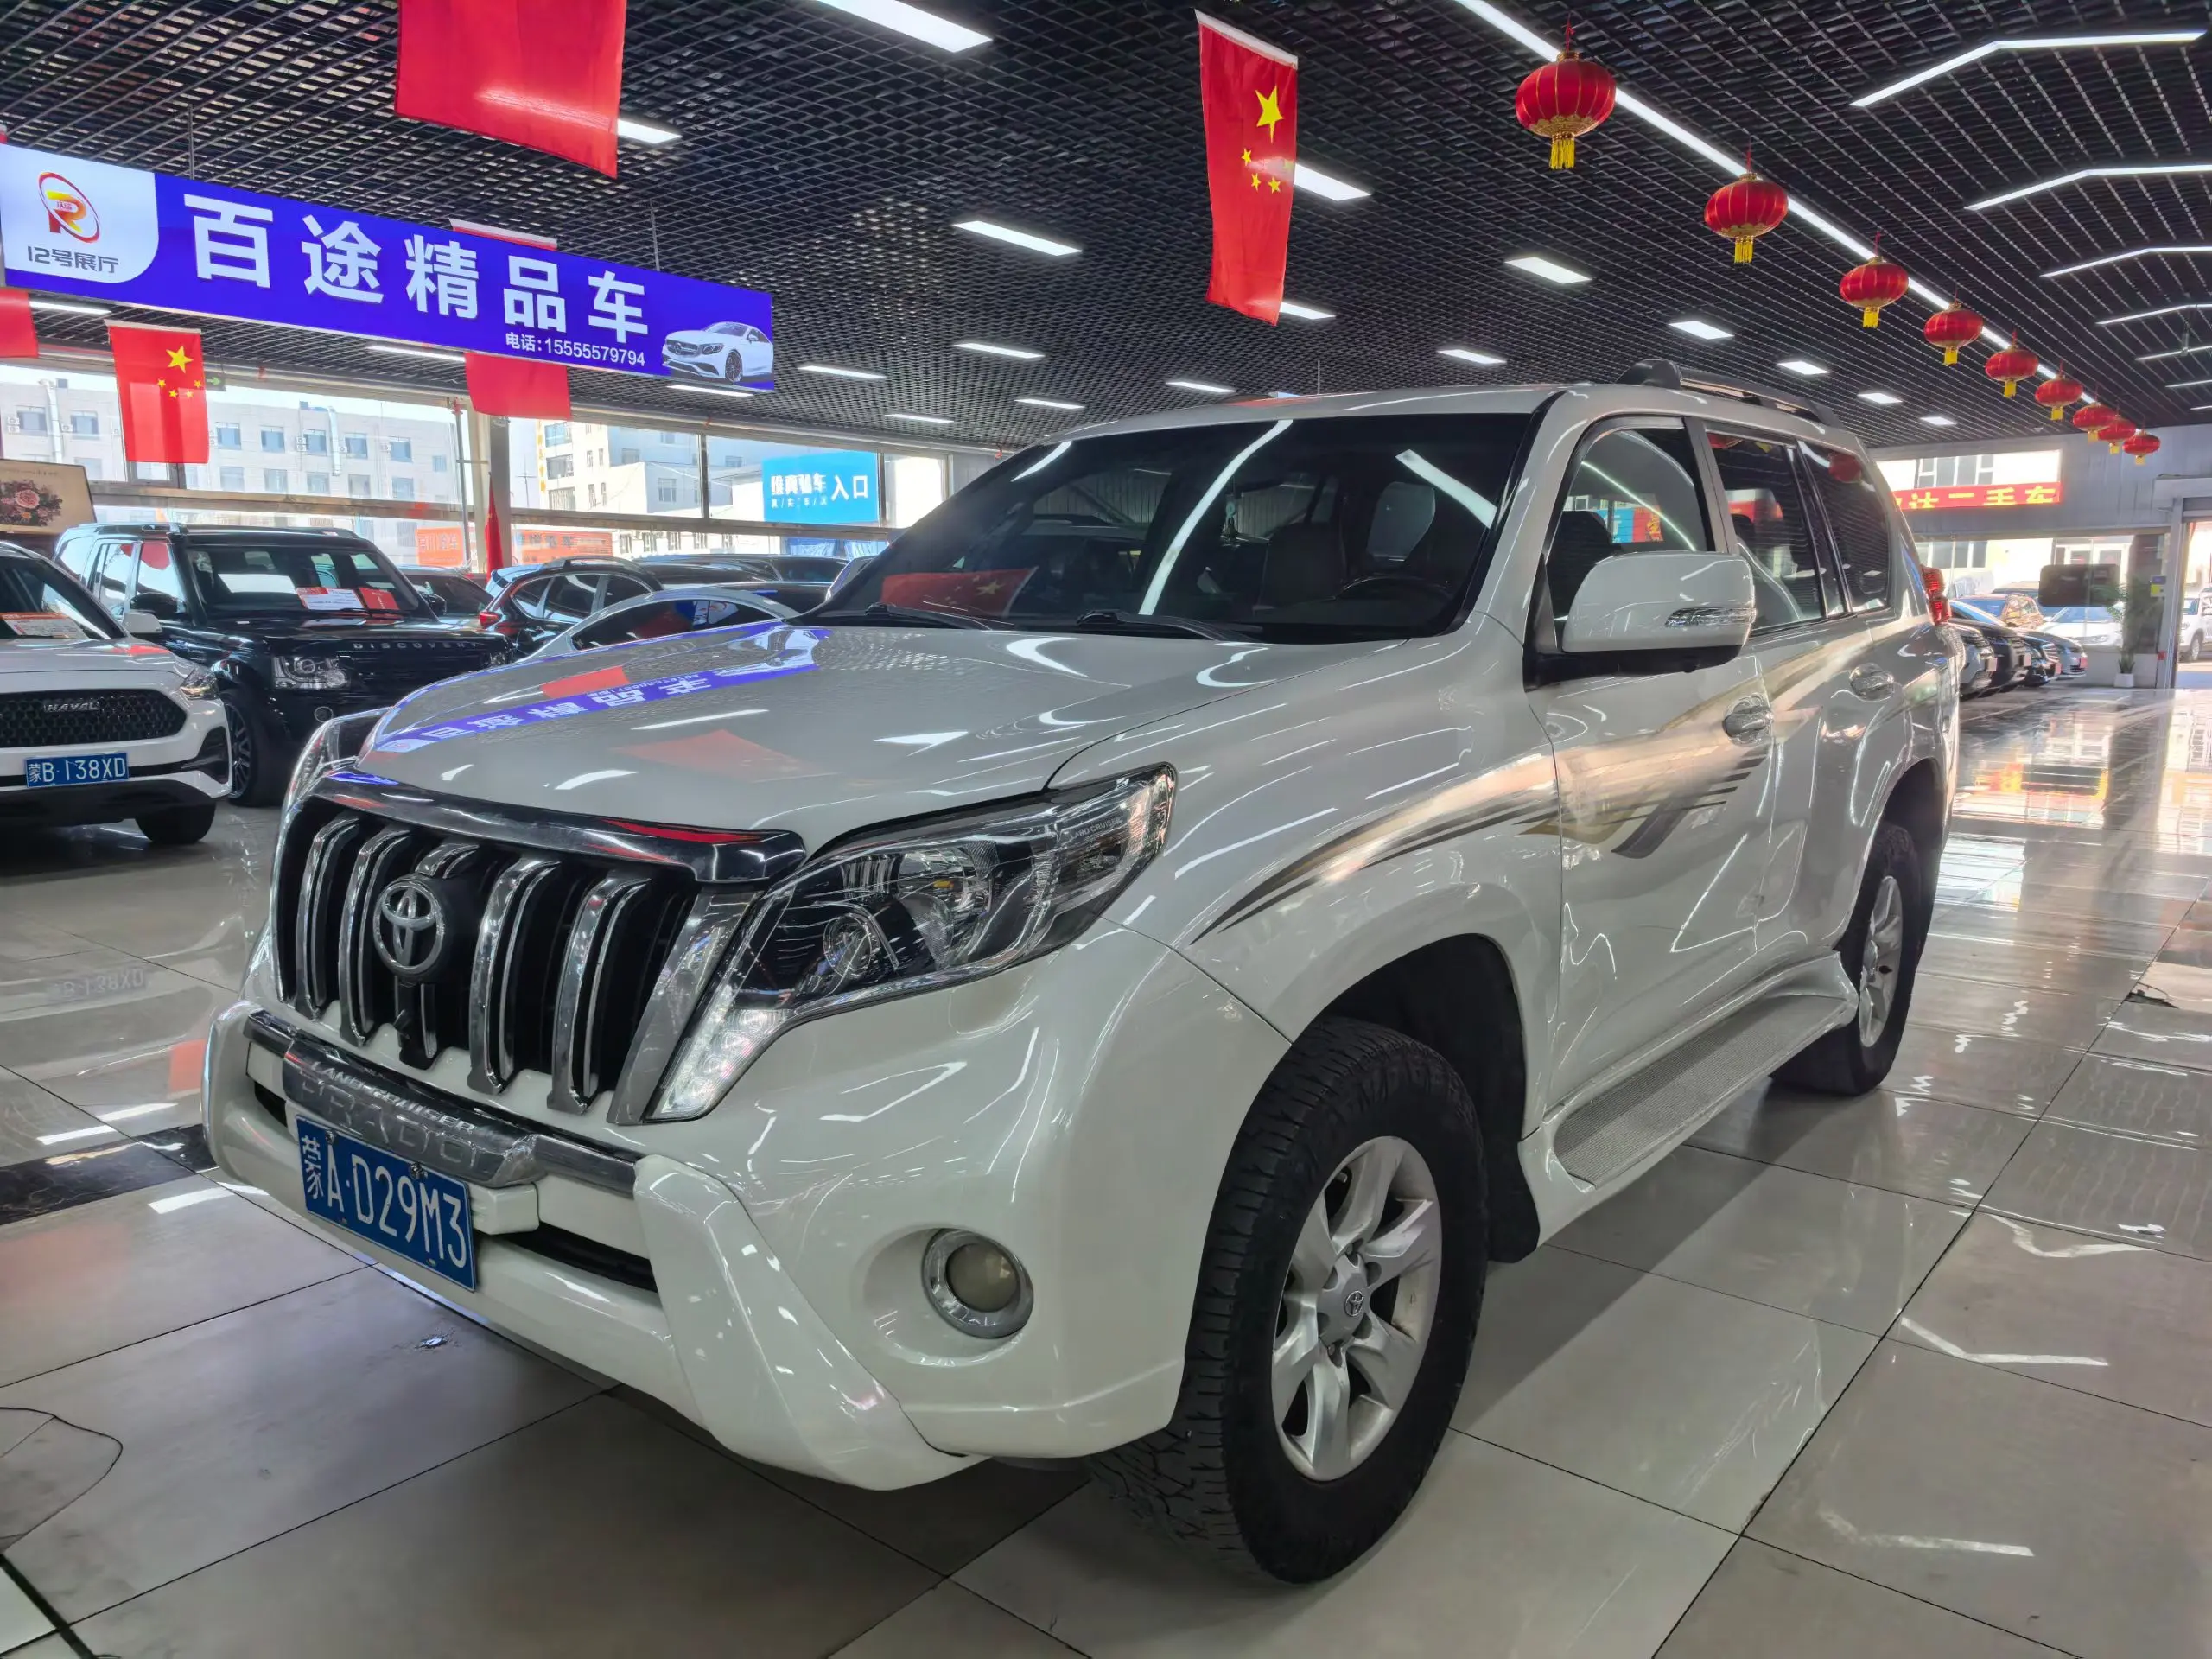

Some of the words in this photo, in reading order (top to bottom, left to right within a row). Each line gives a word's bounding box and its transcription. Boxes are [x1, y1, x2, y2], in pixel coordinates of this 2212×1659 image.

[28, 245, 119, 274] 12号展厅
[184, 193, 649, 344] 百途精品车
[831, 474, 868, 501] 入口
